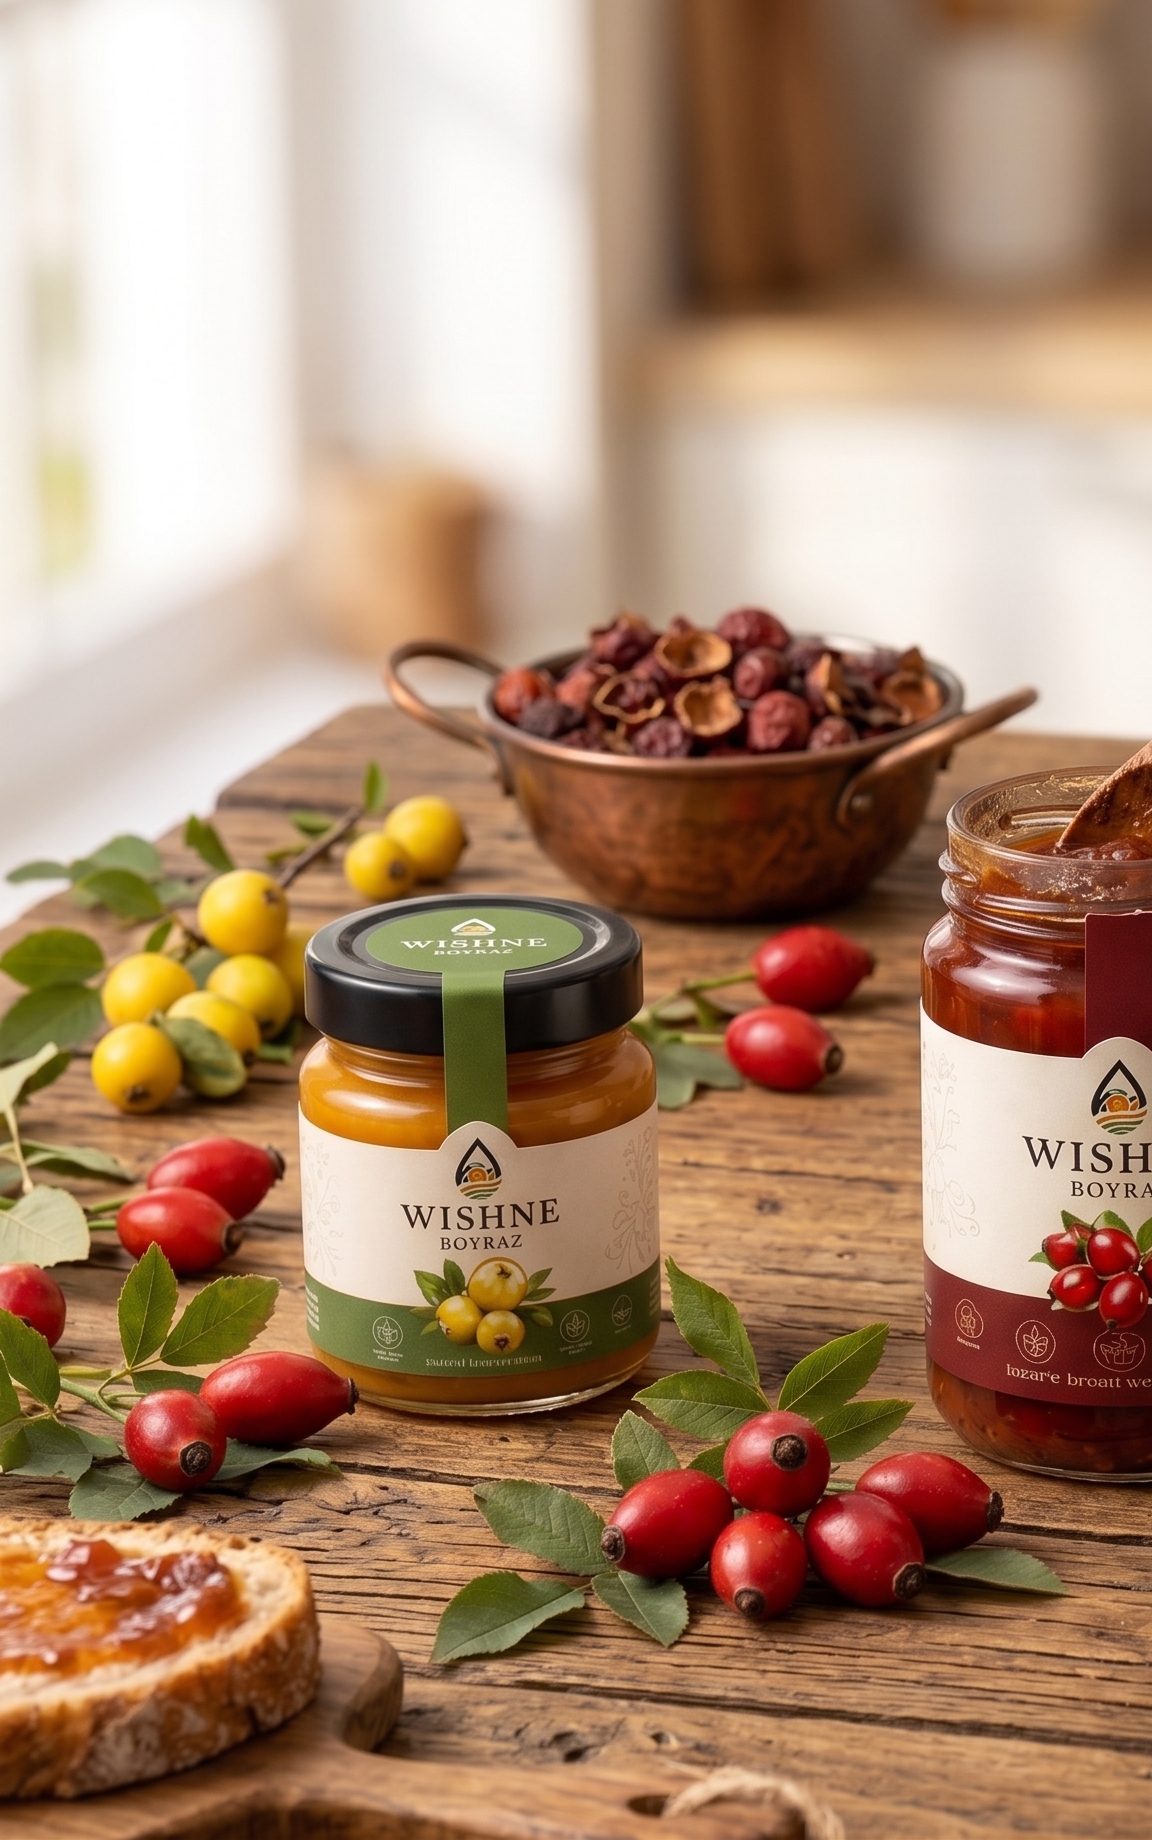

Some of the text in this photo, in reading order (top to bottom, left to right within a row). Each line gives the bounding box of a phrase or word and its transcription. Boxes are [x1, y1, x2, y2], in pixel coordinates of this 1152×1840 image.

[400, 938, 548, 950] WISHNE
[400, 1198, 560, 1231] WISHNE
[440, 1234, 523, 1251] BOYRAZ
